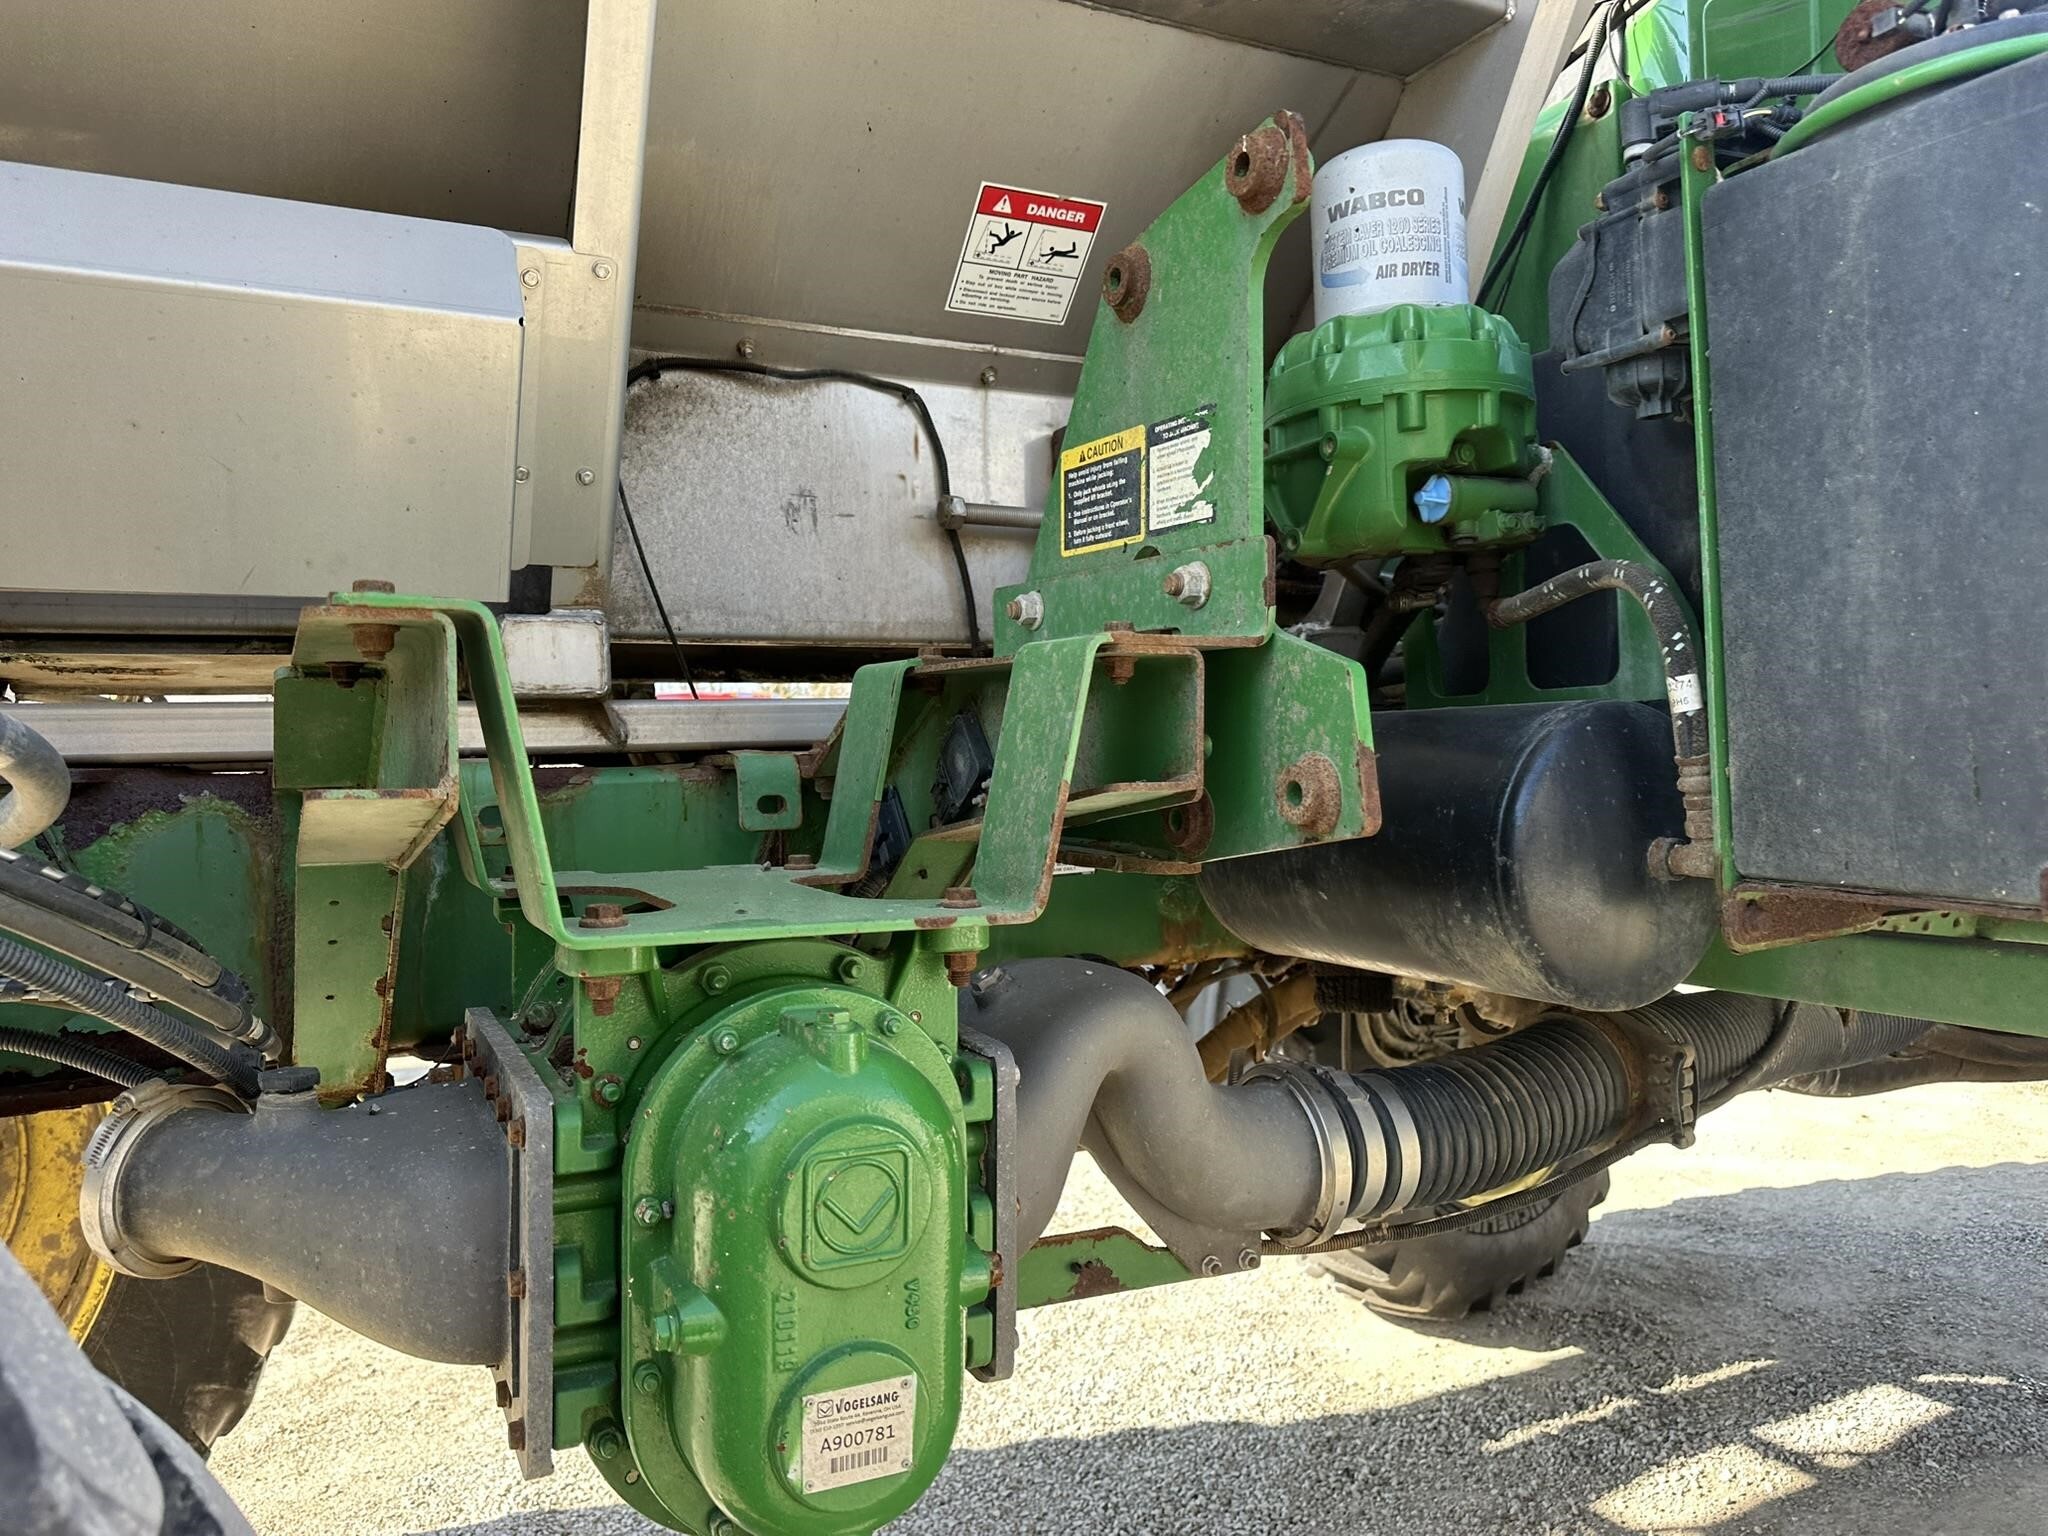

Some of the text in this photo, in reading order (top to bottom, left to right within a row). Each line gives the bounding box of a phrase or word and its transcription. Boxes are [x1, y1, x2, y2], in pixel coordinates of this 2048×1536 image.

[1026, 203, 1086, 224] DANGER
[1328, 189, 1424, 222] WABCO
[1354, 221, 1384, 241] SAVER
[1387, 218, 1410, 235] 1200
[1412, 215, 1441, 234] SERIES
[1360, 242, 1377, 257] OIL
[1379, 234, 1441, 253] COALESCING
[989, 269, 1011, 277] MOVING
[1014, 271, 1028, 279] PART
[1376, 261, 1439, 280] AIR DRYER
[1087, 436, 1124, 459] CAUTION
[1090, 465, 1101, 473] injury
[1114, 457, 1127, 465] falling
[1068, 478, 1085, 487] machine
[1092, 484, 1105, 492] wheels
[1074, 497, 1090, 505] supplied
[1082, 505, 1104, 515] instructions
[1110, 498, 1132, 508] Operator's
[1074, 529, 1086, 537] Before
[1087, 526, 1101, 534] jacking
[836, 1391, 900, 1413] VOGELSANG
[820, 1425, 896, 1454] A900781
